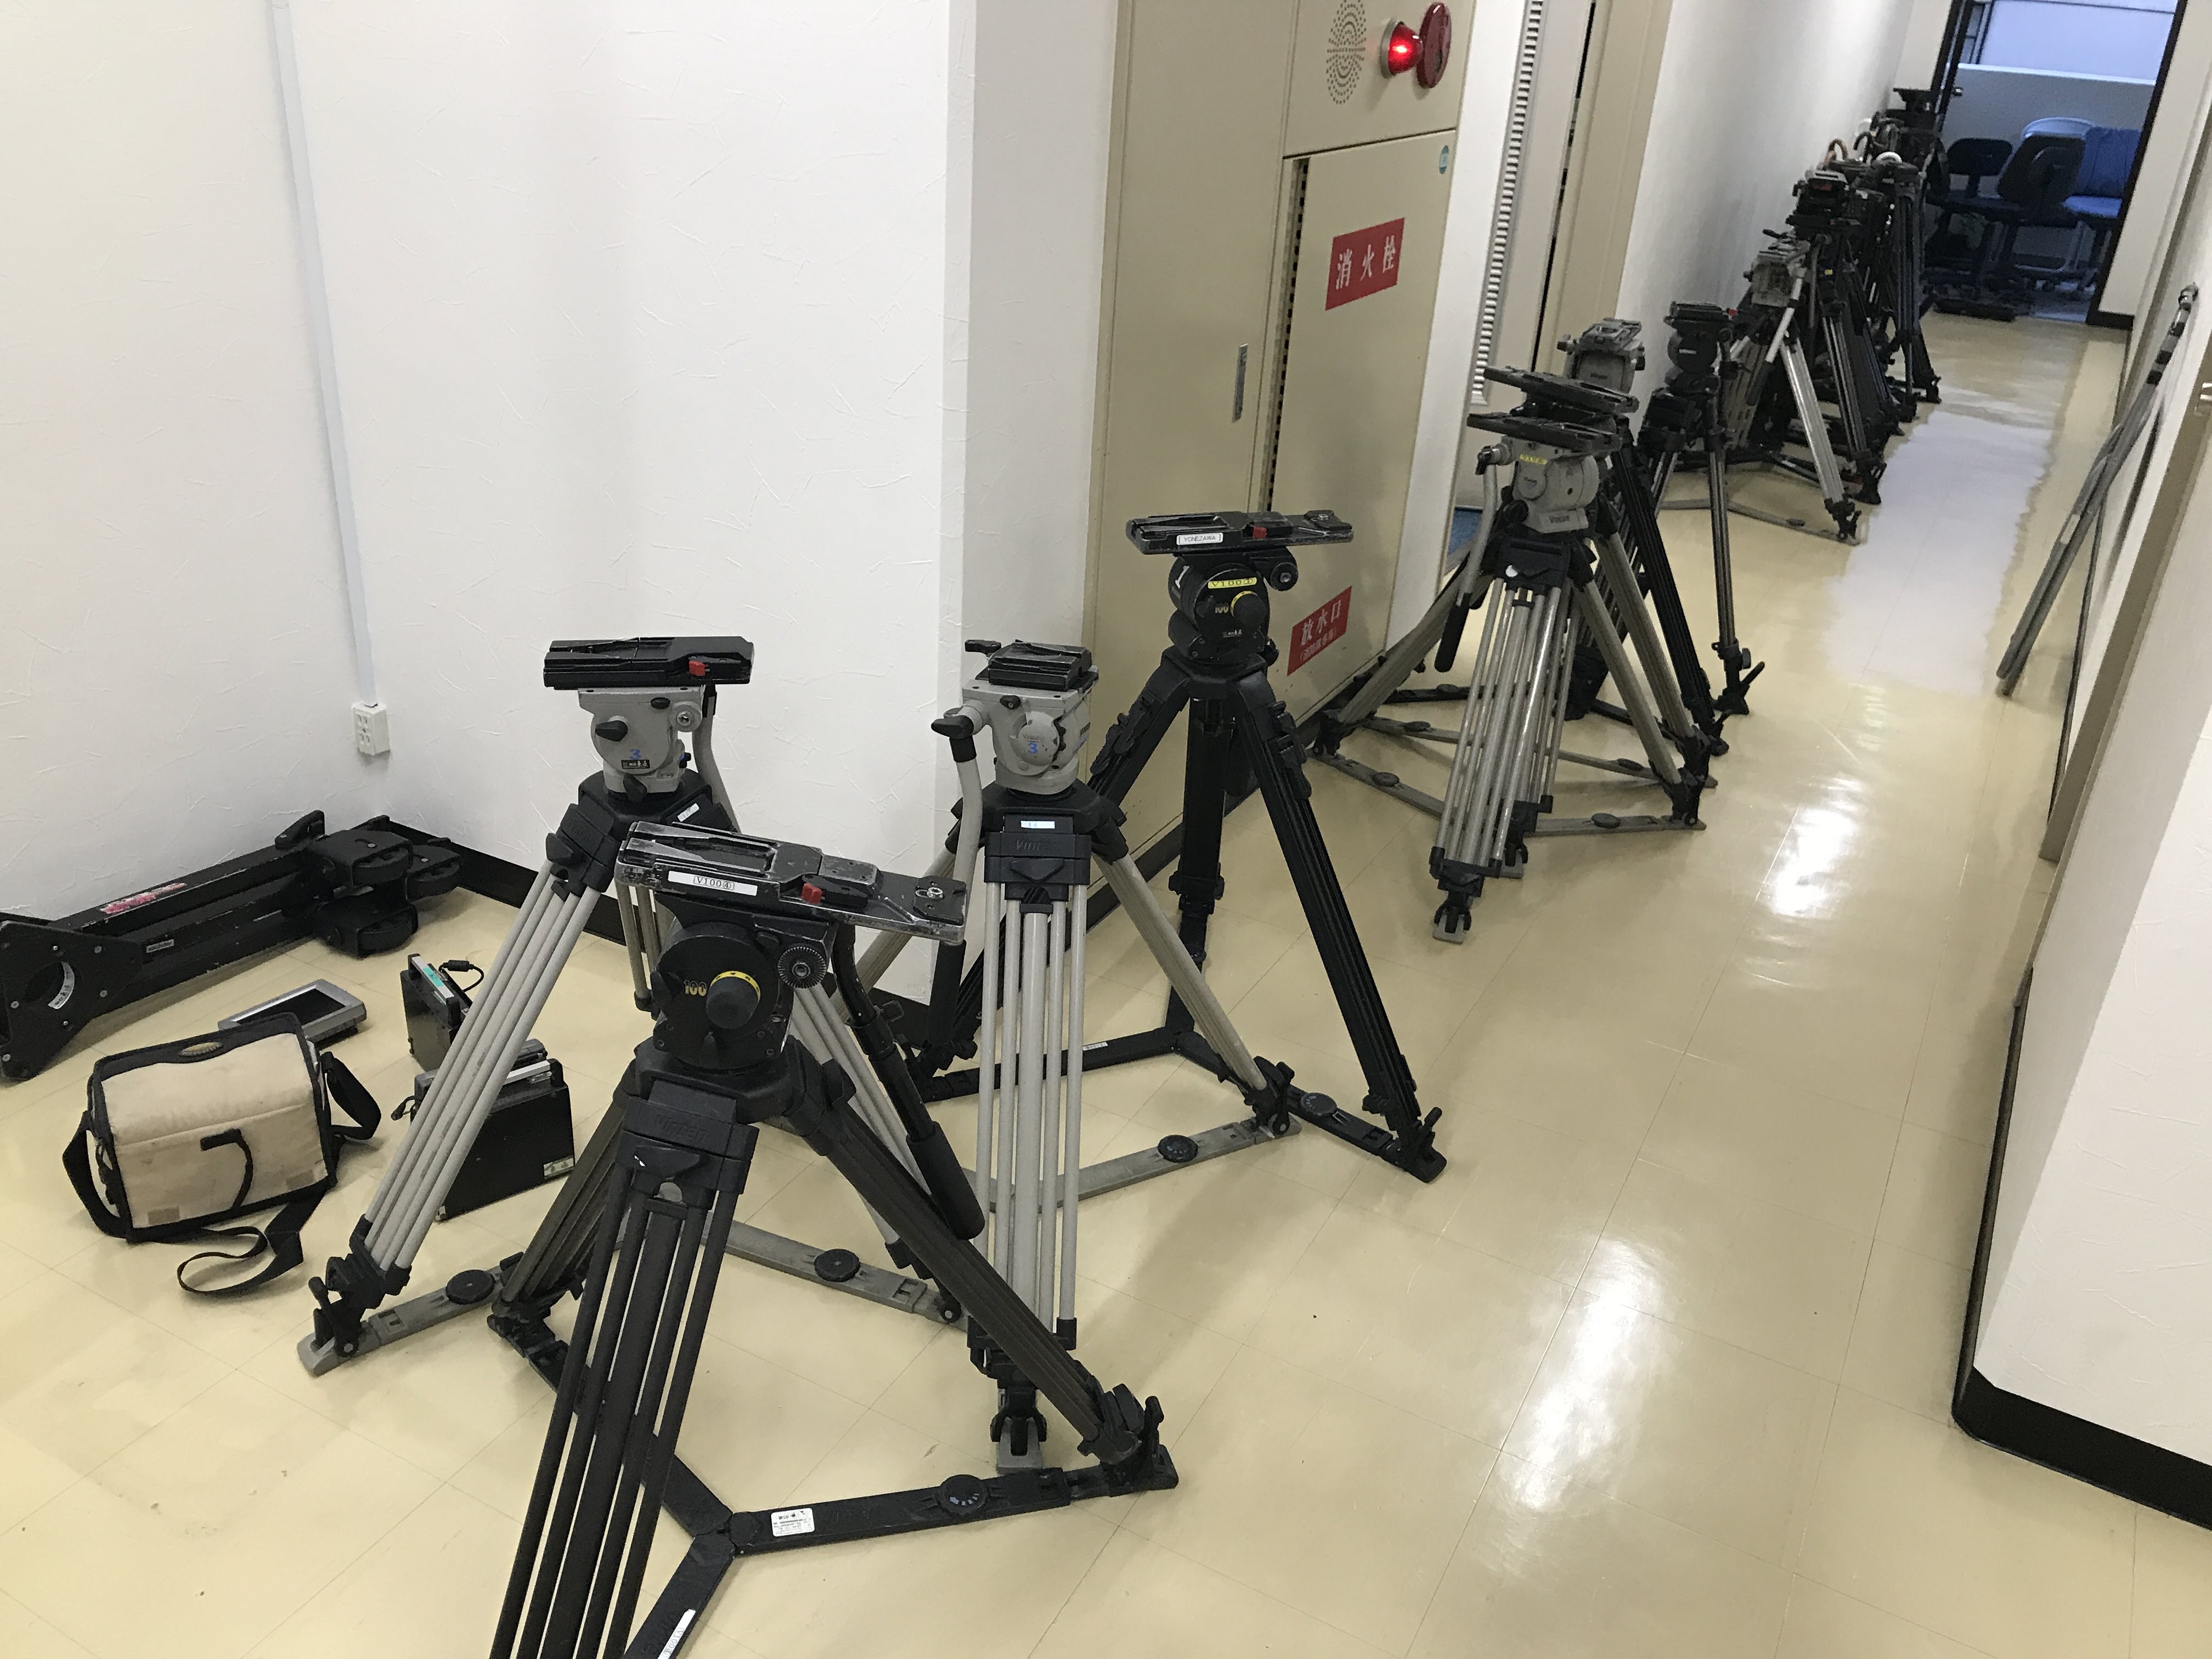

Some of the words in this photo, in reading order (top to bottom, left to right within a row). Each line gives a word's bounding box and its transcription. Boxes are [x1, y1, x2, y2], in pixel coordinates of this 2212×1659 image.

[1336, 235, 1396, 290] 消火栓
[1301, 600, 1341, 646] 放水口
[629, 748, 641, 759] 3
[1028, 742, 1038, 754] 3
[684, 980, 707, 996] 100
